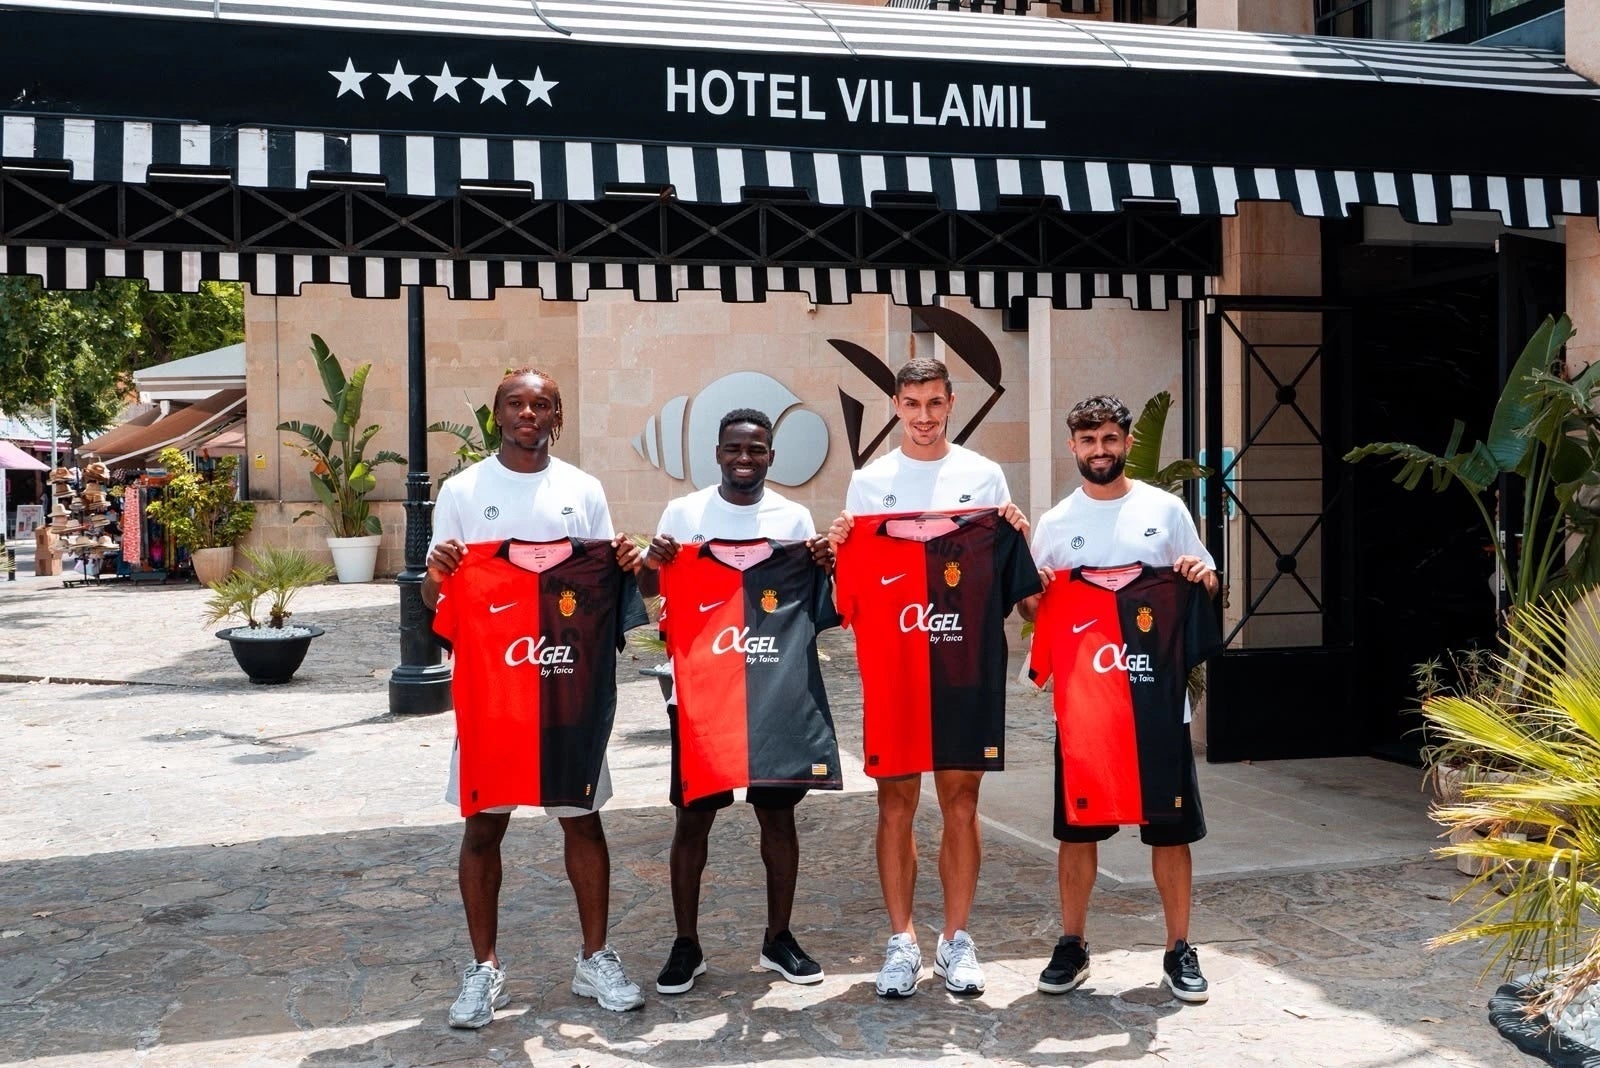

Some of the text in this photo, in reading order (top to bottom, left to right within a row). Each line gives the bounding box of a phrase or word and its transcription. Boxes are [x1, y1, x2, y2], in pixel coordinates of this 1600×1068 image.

[666, 66, 1046, 129] HOTEL VILLAMIL
[930, 633, 963, 644] by Taica
[745, 654, 779, 665] by Taica
[540, 665, 574, 678] by Taica
[1129, 673, 1138, 684] by
